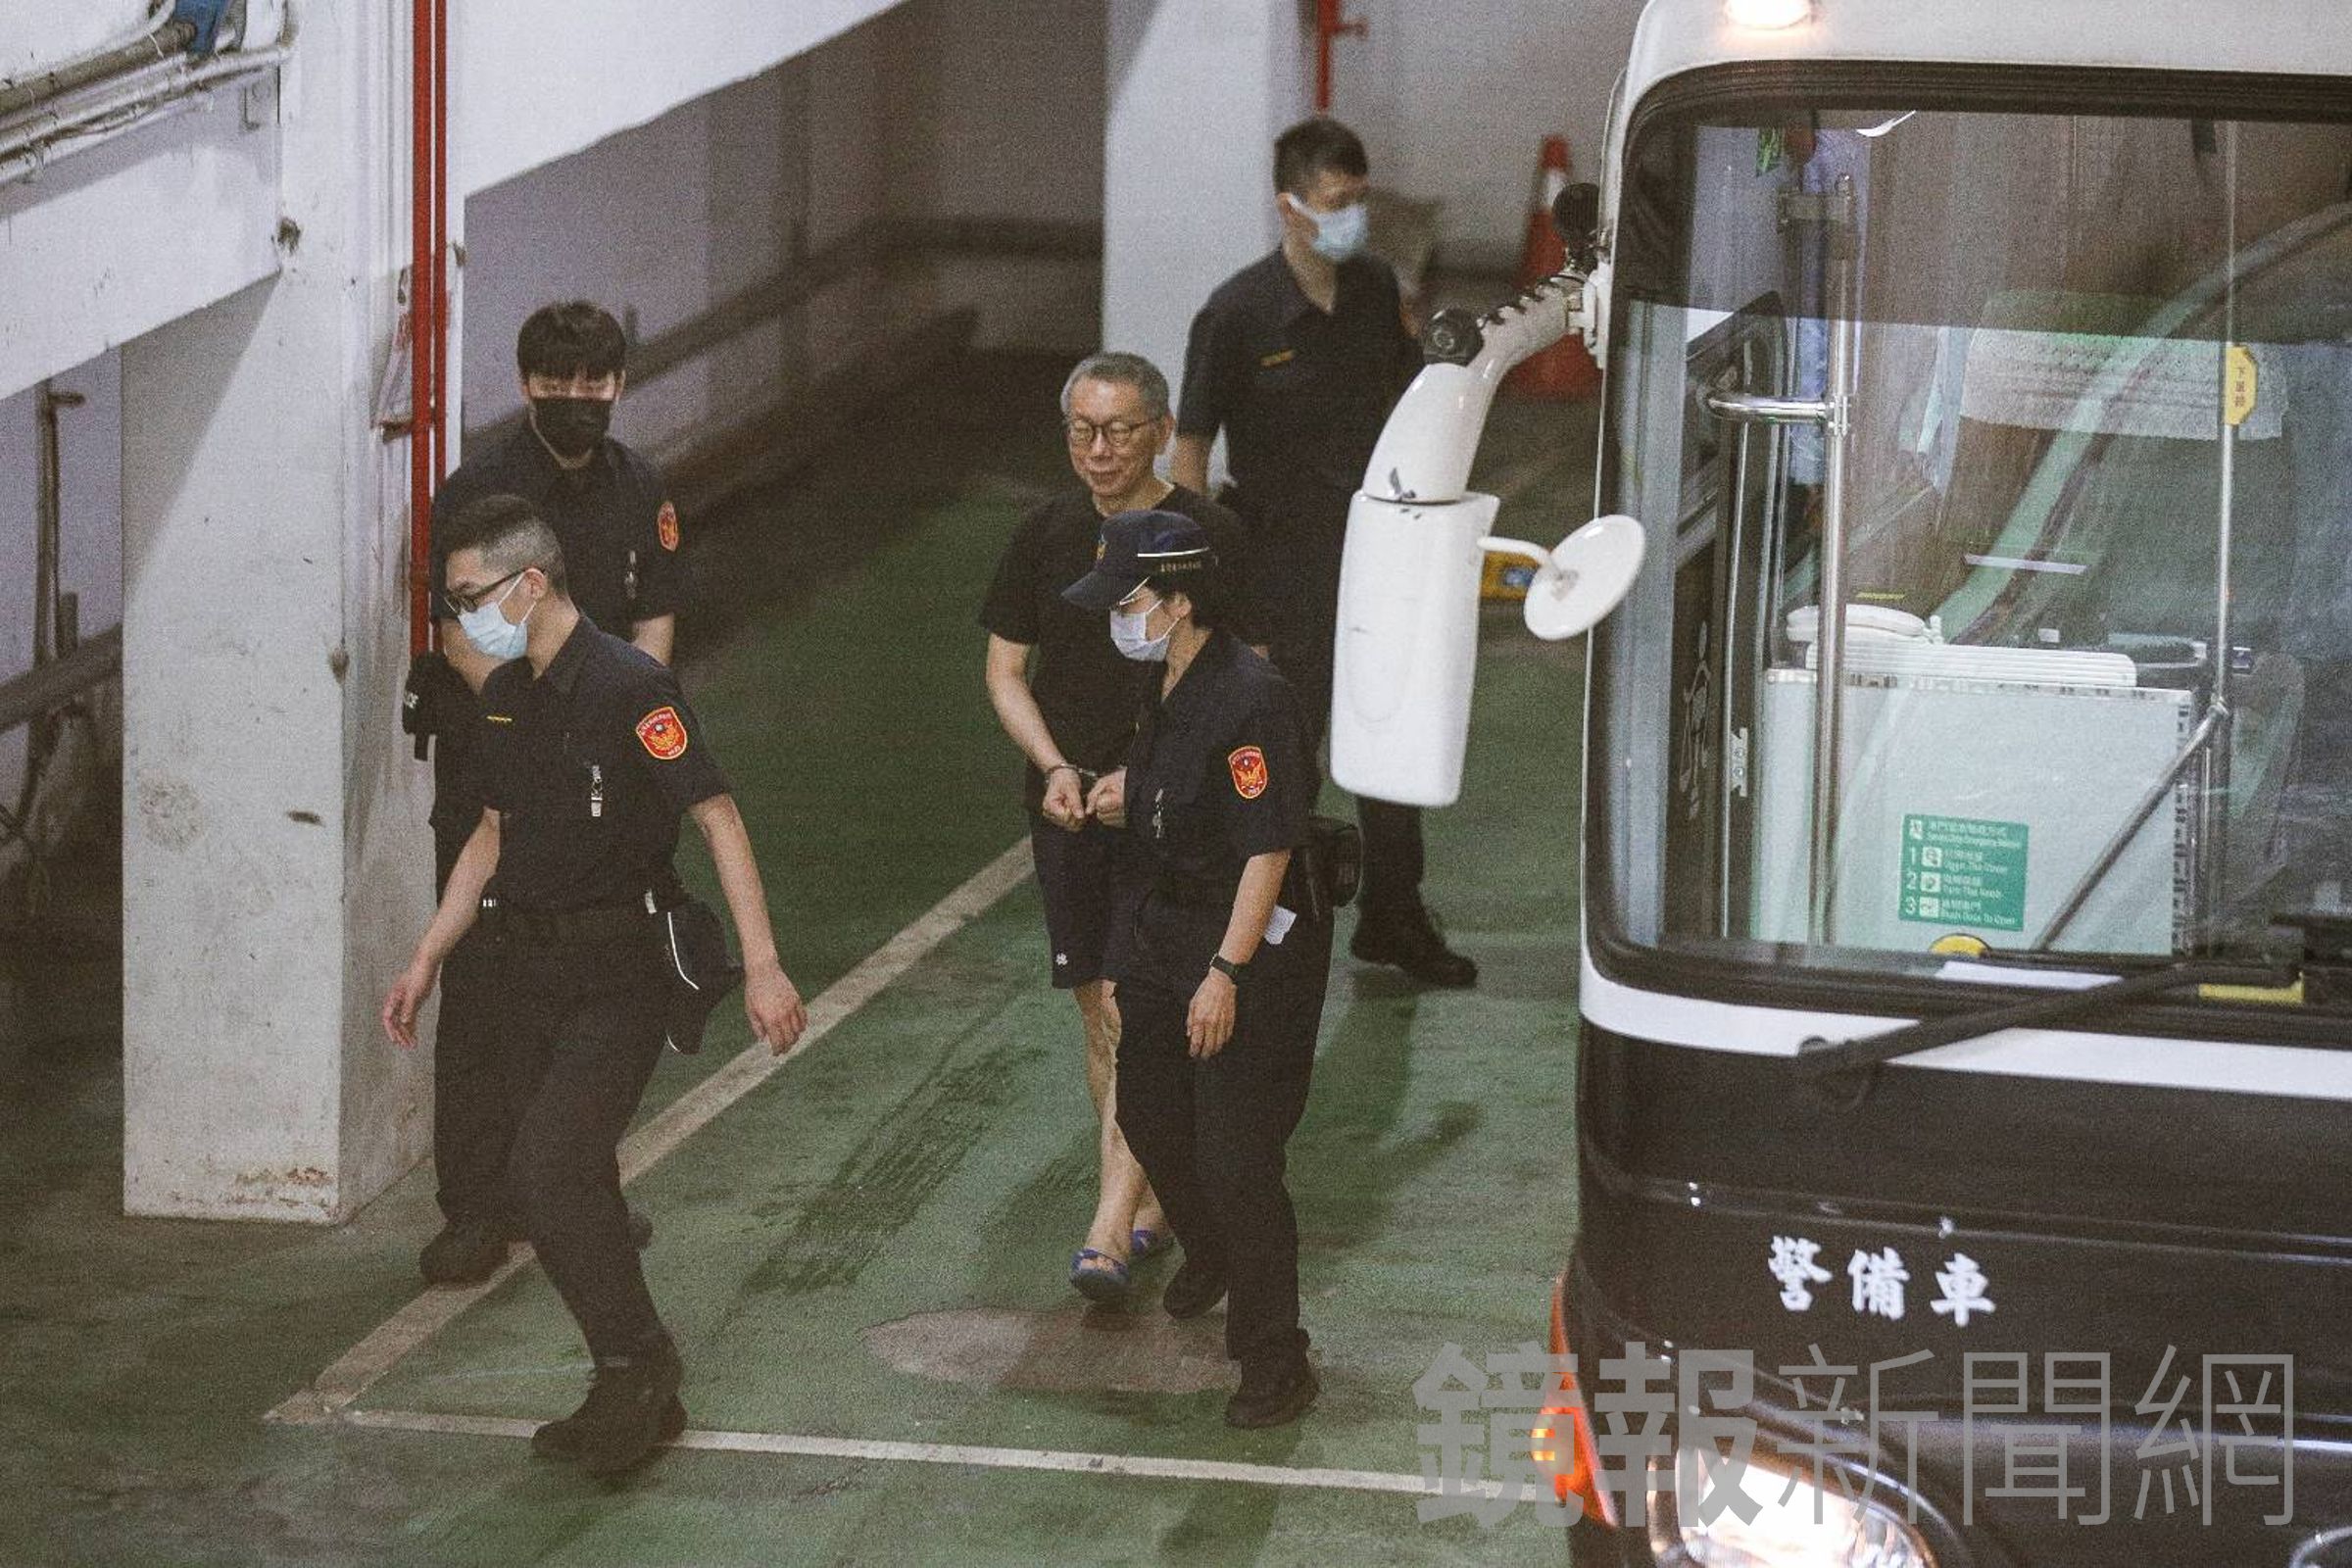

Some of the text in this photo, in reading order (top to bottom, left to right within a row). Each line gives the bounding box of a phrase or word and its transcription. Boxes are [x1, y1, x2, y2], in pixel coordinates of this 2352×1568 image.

[1906, 870, 1917, 890] 2
[1905, 896, 1917, 915] 3
[1768, 1235, 1995, 1328] 警備車
